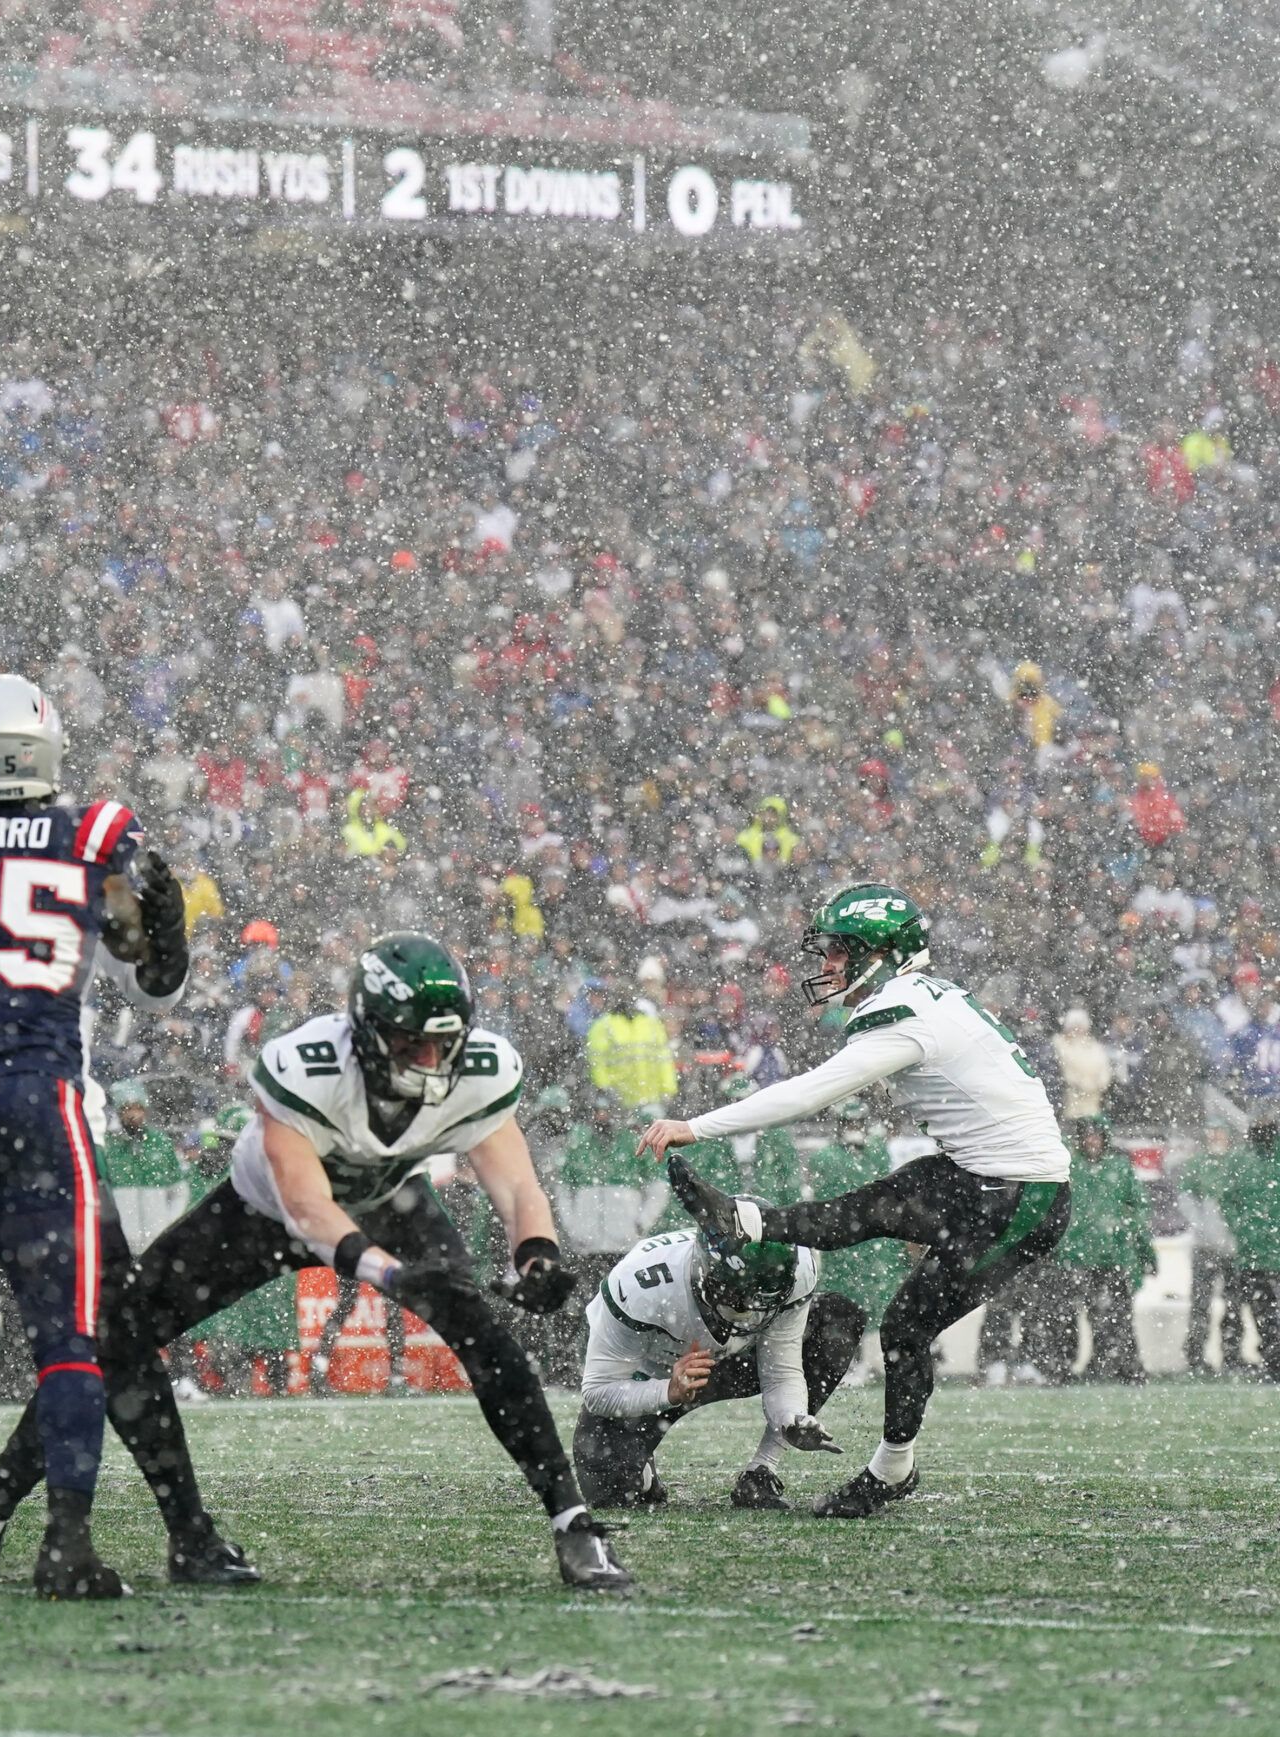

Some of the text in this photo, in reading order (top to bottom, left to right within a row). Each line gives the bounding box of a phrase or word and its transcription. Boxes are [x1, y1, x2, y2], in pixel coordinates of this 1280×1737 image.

[64, 125, 331, 204] 34 RUSH YDS
[381, 148, 621, 220] 2 1ST DOWNS
[667, 166, 719, 238] 0
[839, 898, 907, 917] JETS
[296, 1040, 342, 1078] 81
[634, 1262, 674, 1290] 5
